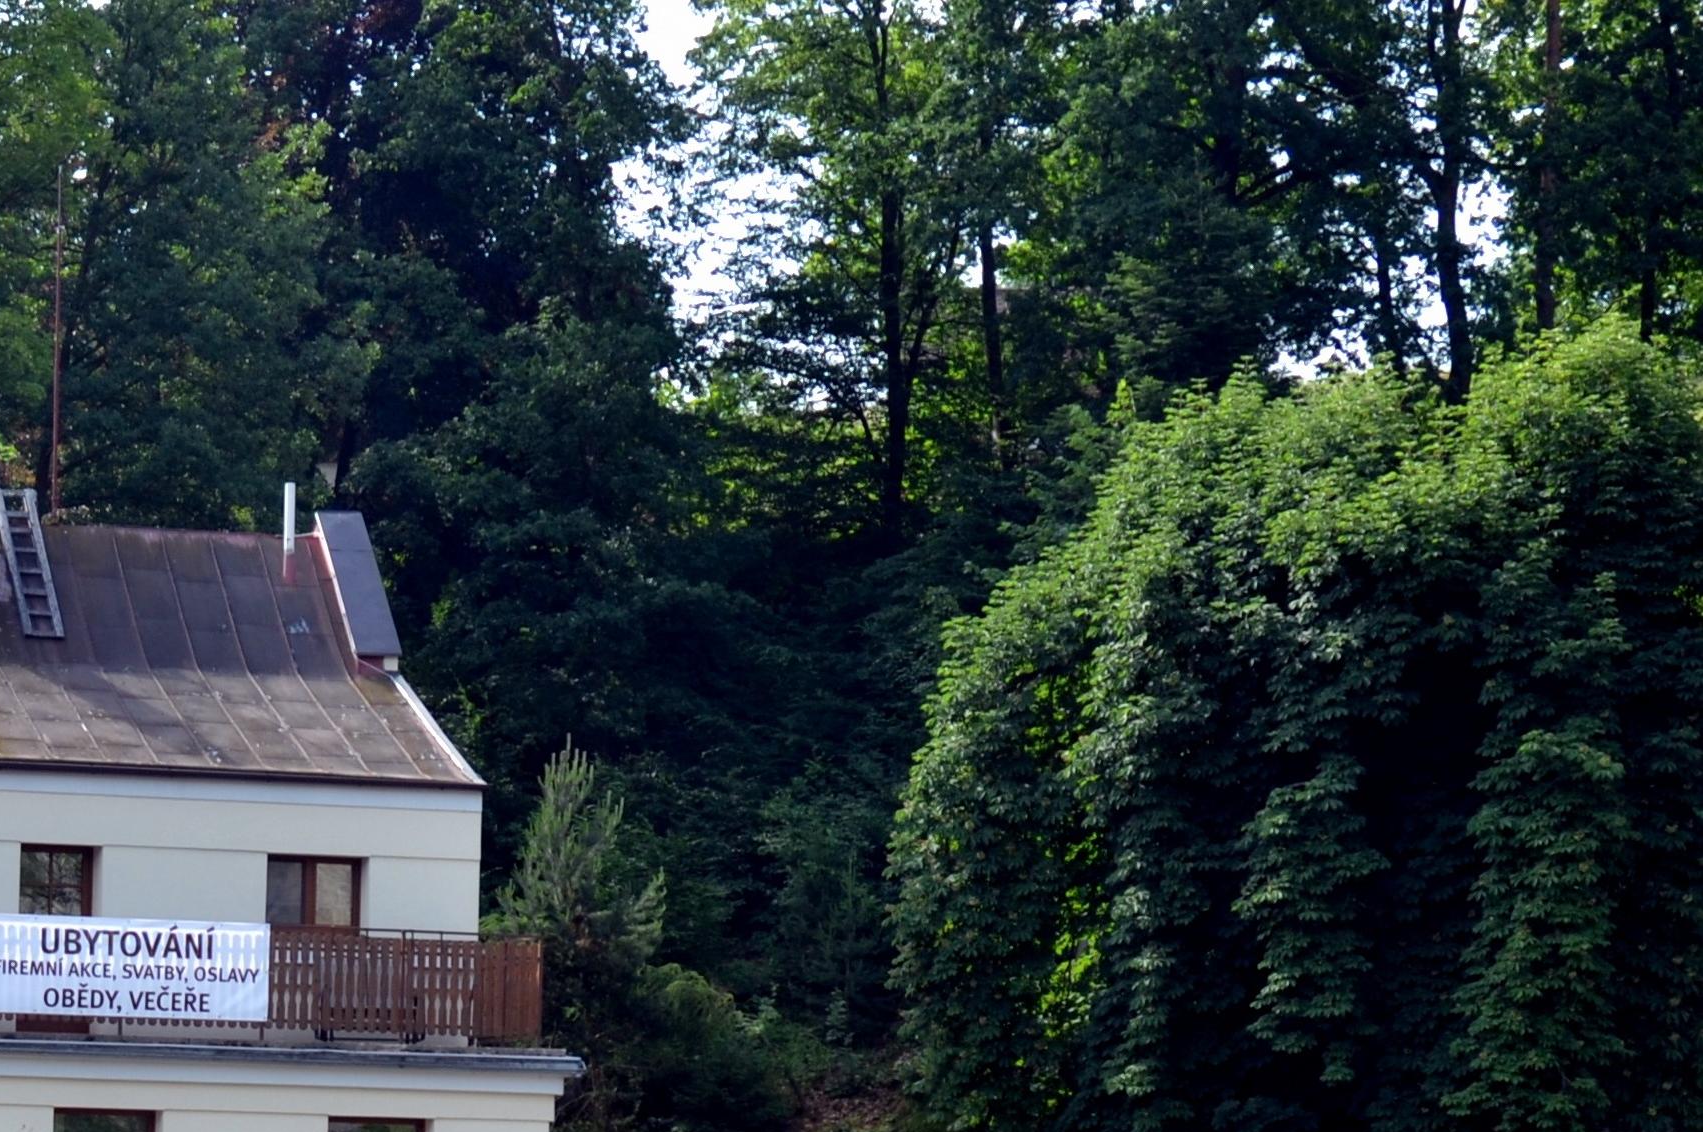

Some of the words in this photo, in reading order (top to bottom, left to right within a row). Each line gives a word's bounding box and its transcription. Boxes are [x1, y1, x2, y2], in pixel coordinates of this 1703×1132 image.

[41, 925, 215, 960] UBYTOVÁNÍ
[68, 962, 117, 981] AKCE,
[122, 963, 188, 983] SVATBY,
[194, 966, 259, 983] OSLAVY
[43, 982, 122, 1013] OBĚDY,
[129, 986, 210, 1013] VEČEŘE
